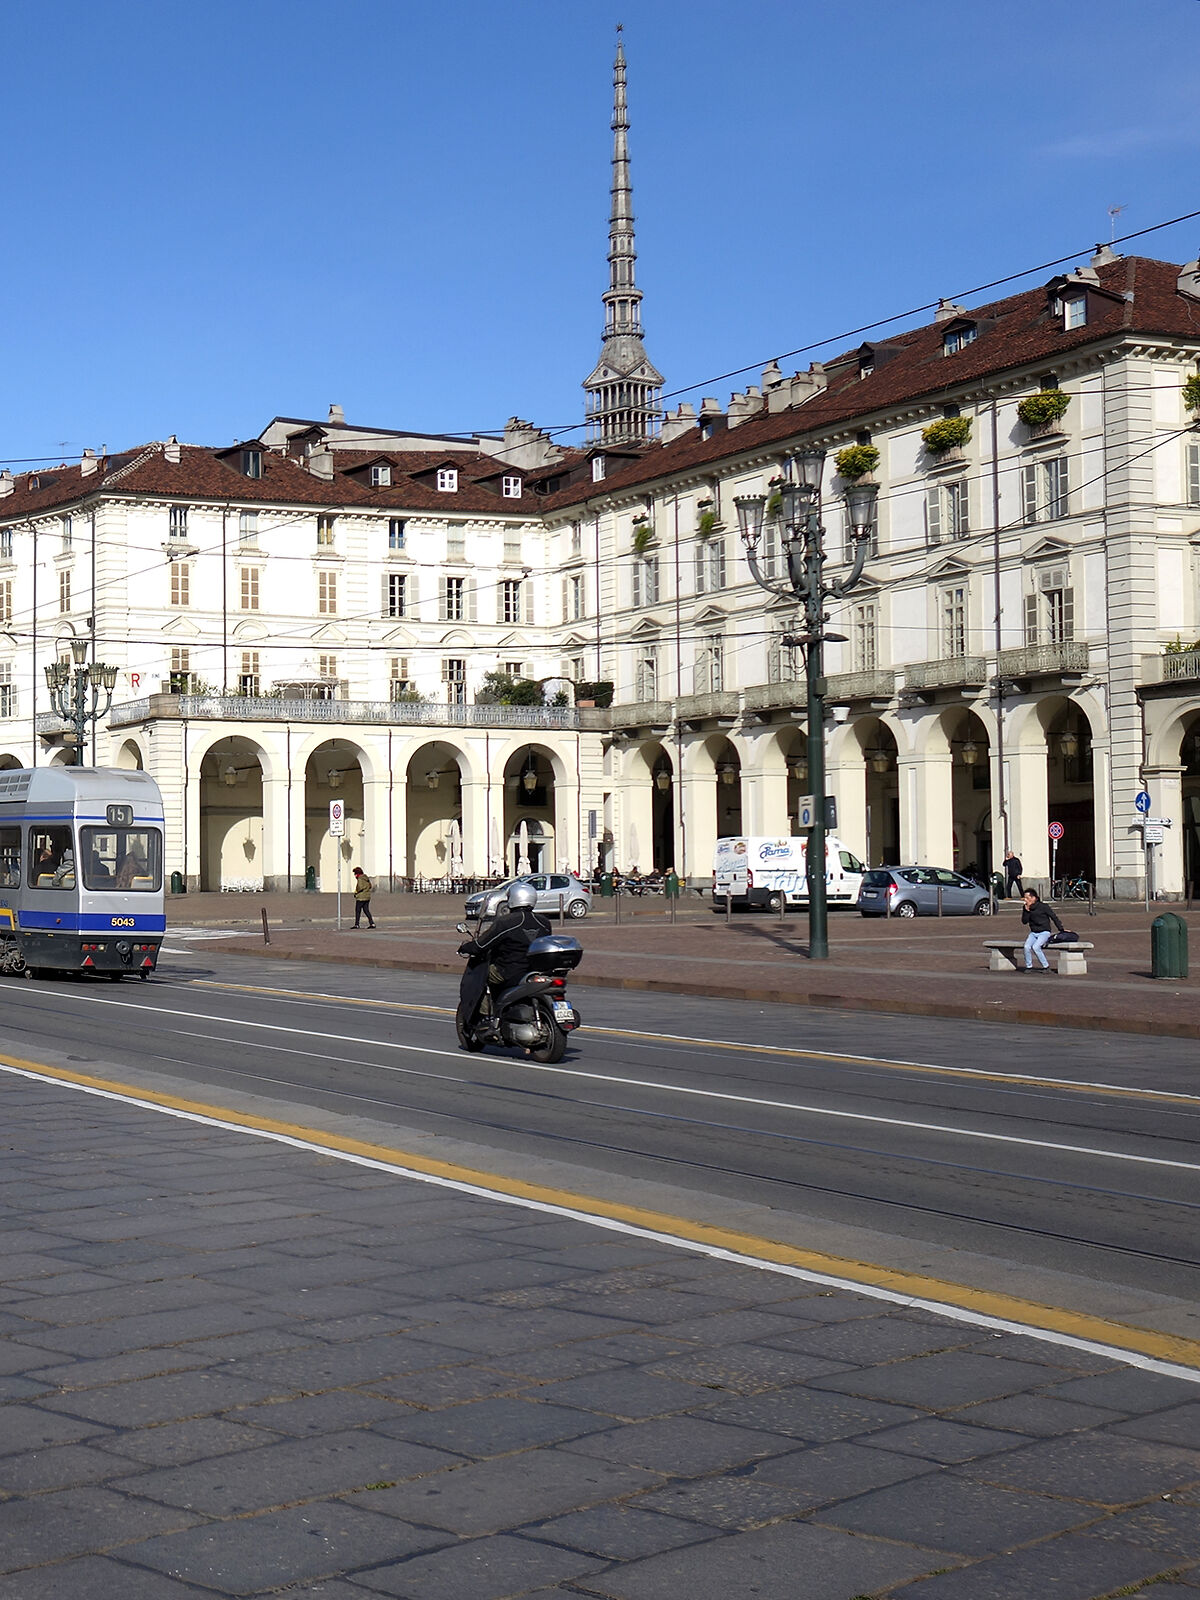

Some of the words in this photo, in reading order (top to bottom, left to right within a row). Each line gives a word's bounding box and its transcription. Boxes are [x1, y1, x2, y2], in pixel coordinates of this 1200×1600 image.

[132, 673, 141, 687] R
[110, 808, 125, 821] 15
[111, 917, 135, 927] 5043
